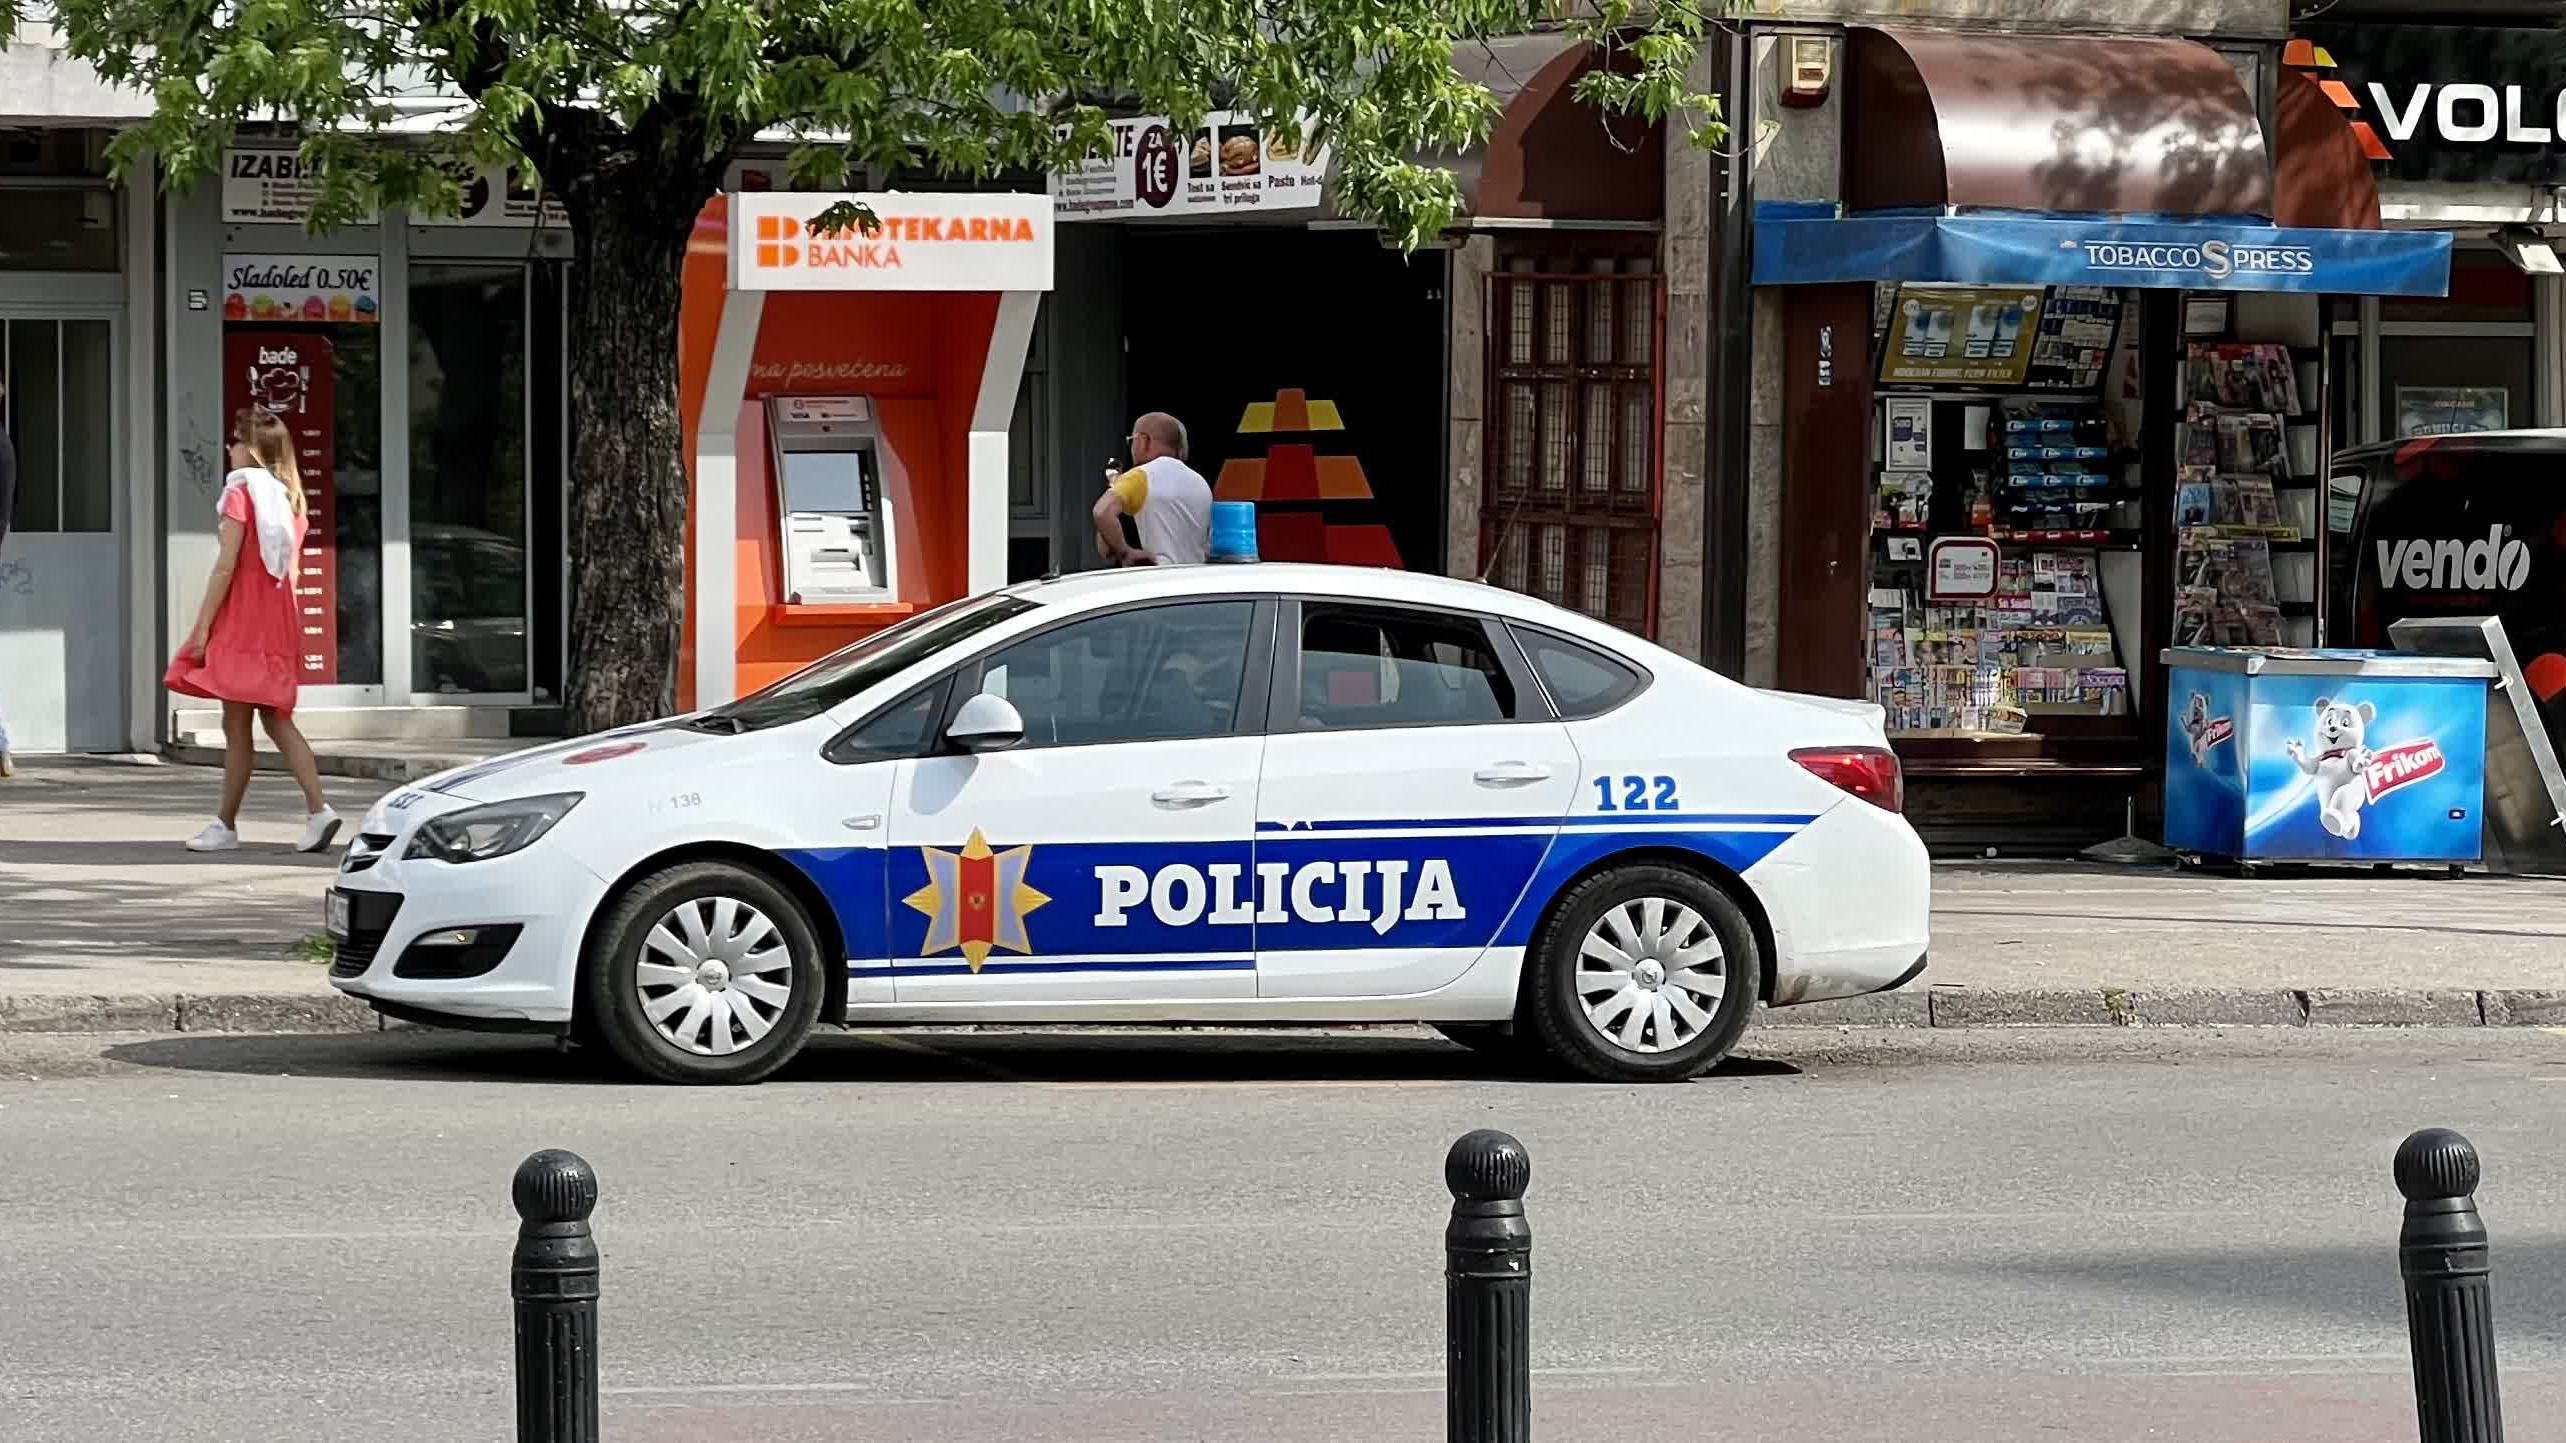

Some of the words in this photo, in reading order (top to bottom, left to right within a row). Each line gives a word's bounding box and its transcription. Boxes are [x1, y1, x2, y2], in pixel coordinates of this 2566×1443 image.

[2367, 82, 2566, 143] VOL
[1149, 132, 1163, 148] ZA
[1141, 151, 1168, 193] 1€
[807, 245, 903, 268] BANKA
[227, 264, 316, 290] Sladoled
[316, 268, 373, 291] 0.50€
[258, 346, 298, 365] bade
[2376, 523, 2531, 591] vendo
[669, 791, 703, 809] 138
[1593, 775, 1679, 811] 122
[1093, 859, 1467, 936] POLICIJA
